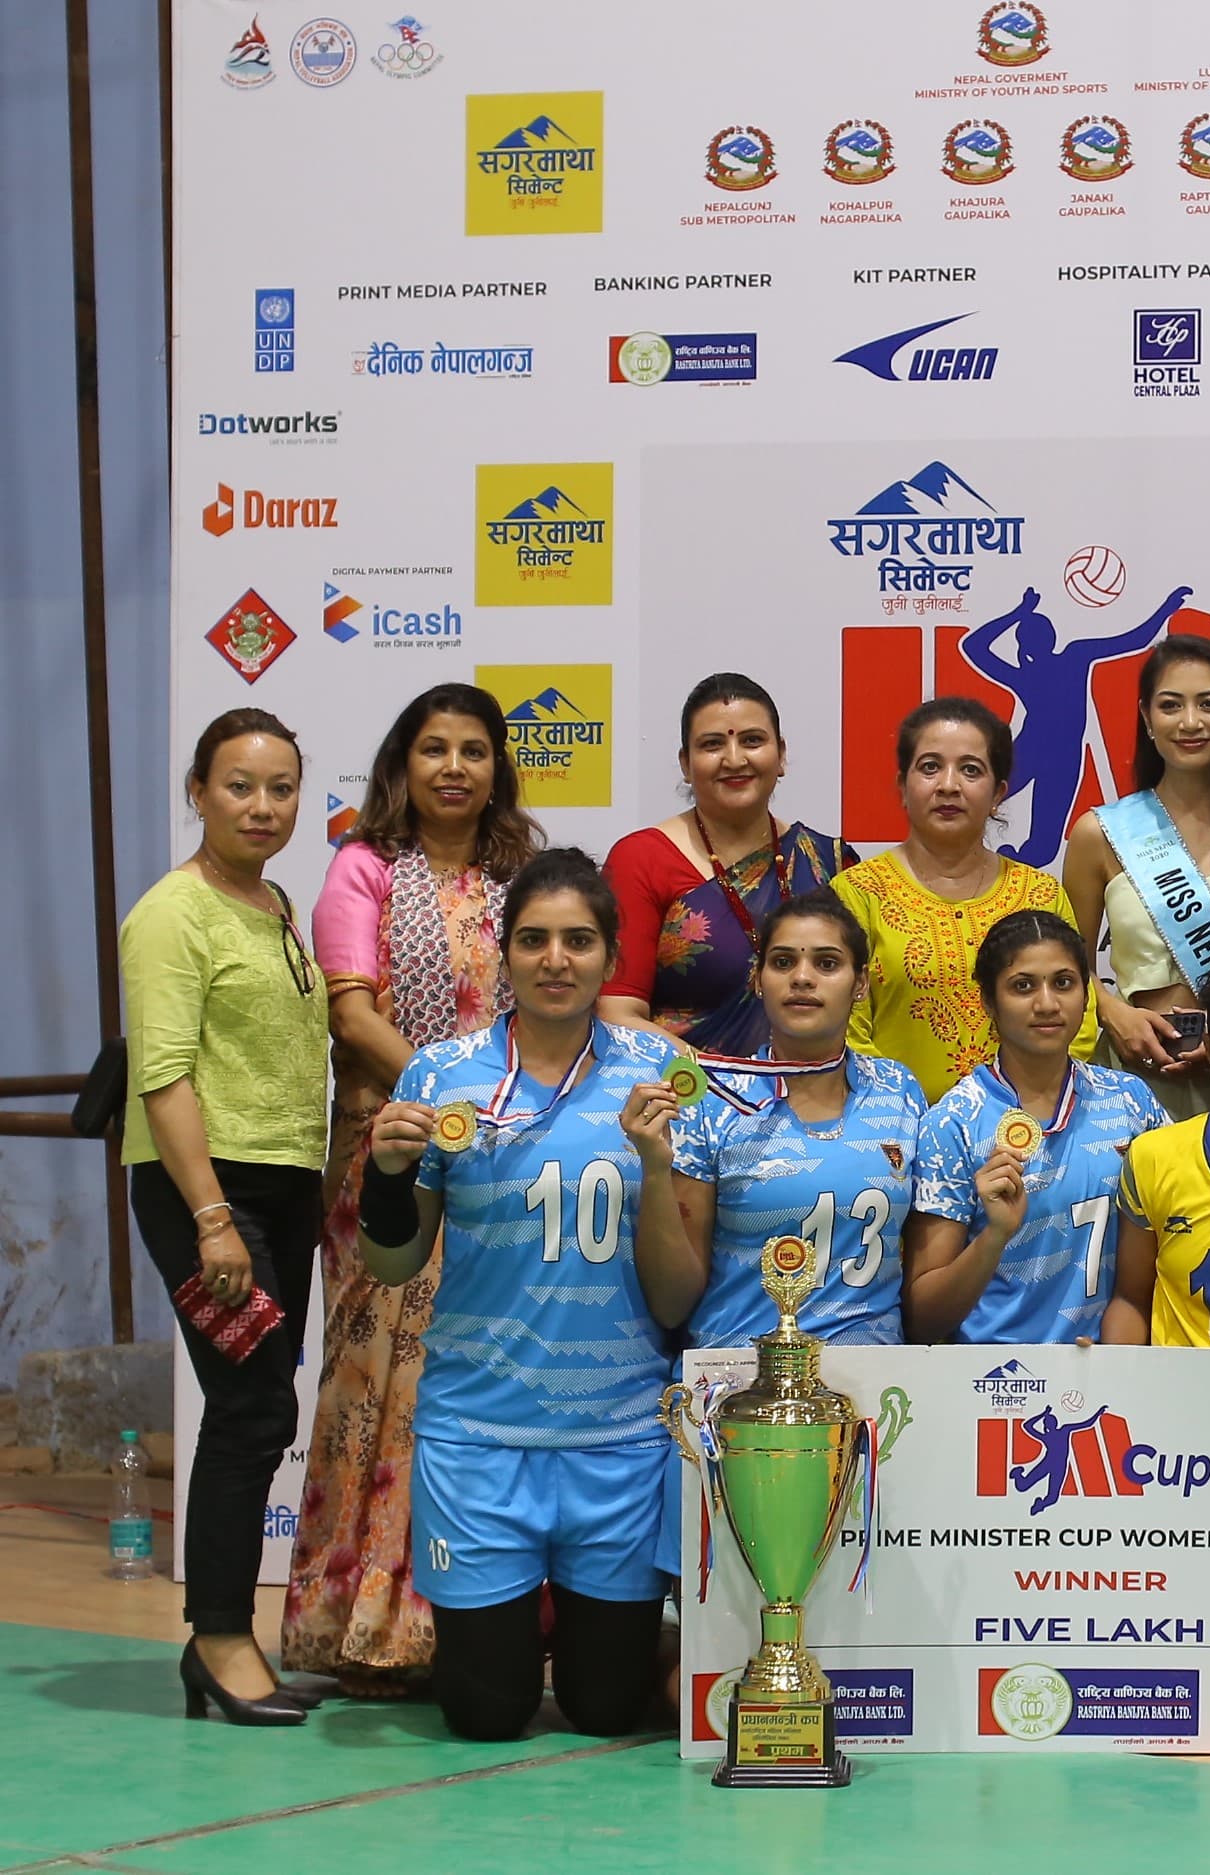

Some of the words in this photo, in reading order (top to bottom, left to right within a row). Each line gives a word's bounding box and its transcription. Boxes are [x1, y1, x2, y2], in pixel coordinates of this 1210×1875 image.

[954, 75, 992, 85] NEPAL
[995, 72, 1068, 83] GOVERMENT
[1135, 82, 1188, 91] MINISTRY
[1192, 80, 1207, 90] OF
[915, 88, 968, 98] MINISTRY
[971, 87, 987, 96] OF
[990, 86, 1030, 96] YOUTH
[1033, 85, 1058, 95] AND
[1062, 84, 1108, 95] SPORTS
[476, 148, 595, 173] सगरमाथा
[507, 174, 565, 195] सिमेन्ट
[704, 202, 772, 212] NEPALGUNJ
[828, 200, 893, 211] KOHALPUR
[950, 197, 1005, 207] KHAJURA
[1070, 193, 1113, 203] JANAKI
[680, 217, 703, 226] SUB
[707, 214, 796, 225] METROPOLITAN
[820, 213, 902, 224] NAGARPALIKA
[944, 210, 1011, 220] GAUPALIKA
[1059, 206, 1126, 216] GAUPALIKA
[853, 269, 883, 284] KIT
[889, 267, 977, 283] PARTNER
[1058, 264, 1181, 281] HOSPITALITY
[339, 286, 391, 300] PRINT
[397, 284, 457, 298] MEDIA
[462, 281, 547, 297] PARTNER
[594, 275, 680, 292] BANKING
[686, 273, 772, 290] PARTNER
[367, 341, 424, 376] दैनिक
[431, 341, 533, 375] नेपालगन्ज
[1134, 367, 1201, 383] HOTEL
[1134, 386, 1171, 397] CENTRAL
[1174, 385, 1201, 396] PLAZA
[199, 411, 337, 434] Dotworks
[244, 490, 338, 528] Daraz
[486, 519, 605, 545] सगरमाथा
[827, 517, 1025, 556] सगरमाथा
[517, 546, 574, 566] सिमेन्ट
[332, 568, 366, 576] DIGITAL
[369, 567, 409, 576] PAYMENT
[412, 566, 453, 575] PARTNER
[878, 557, 974, 592] सिमेन्ट
[373, 604, 461, 635] iCash
[505, 722, 604, 745] गरमाथा
[516, 746, 573, 768] सिमेन्ट
[1153, 868, 1203, 923] MISS
[525, 1159, 624, 1263] 10
[801, 1188, 890, 1288] 13
[1071, 1195, 1110, 1298] 7
[973, 1379, 1048, 1393] सगरमाथा
[992, 1394, 1027, 1406] सिमेन्ट
[931, 1529, 1050, 1547] MINISTER
[1059, 1530, 1112, 1547] CUP
[429, 1538, 450, 1572] 10
[1014, 1570, 1167, 1592] WINNER
[975, 1617, 1071, 1642] FIVE
[1087, 1617, 1204, 1642] LAKH
[801, 1714, 819, 1725] कप
[834, 1706, 865, 1720] ANIJYA
[866, 1706, 886, 1719] BANK
[888, 1706, 906, 1719] LTD.
[1077, 1705, 1116, 1719] RASTRIYA
[1118, 1705, 1150, 1720] BANIJYA
[1152, 1705, 1172, 1720] BANK
[1174, 1706, 1192, 1719] LTD.
